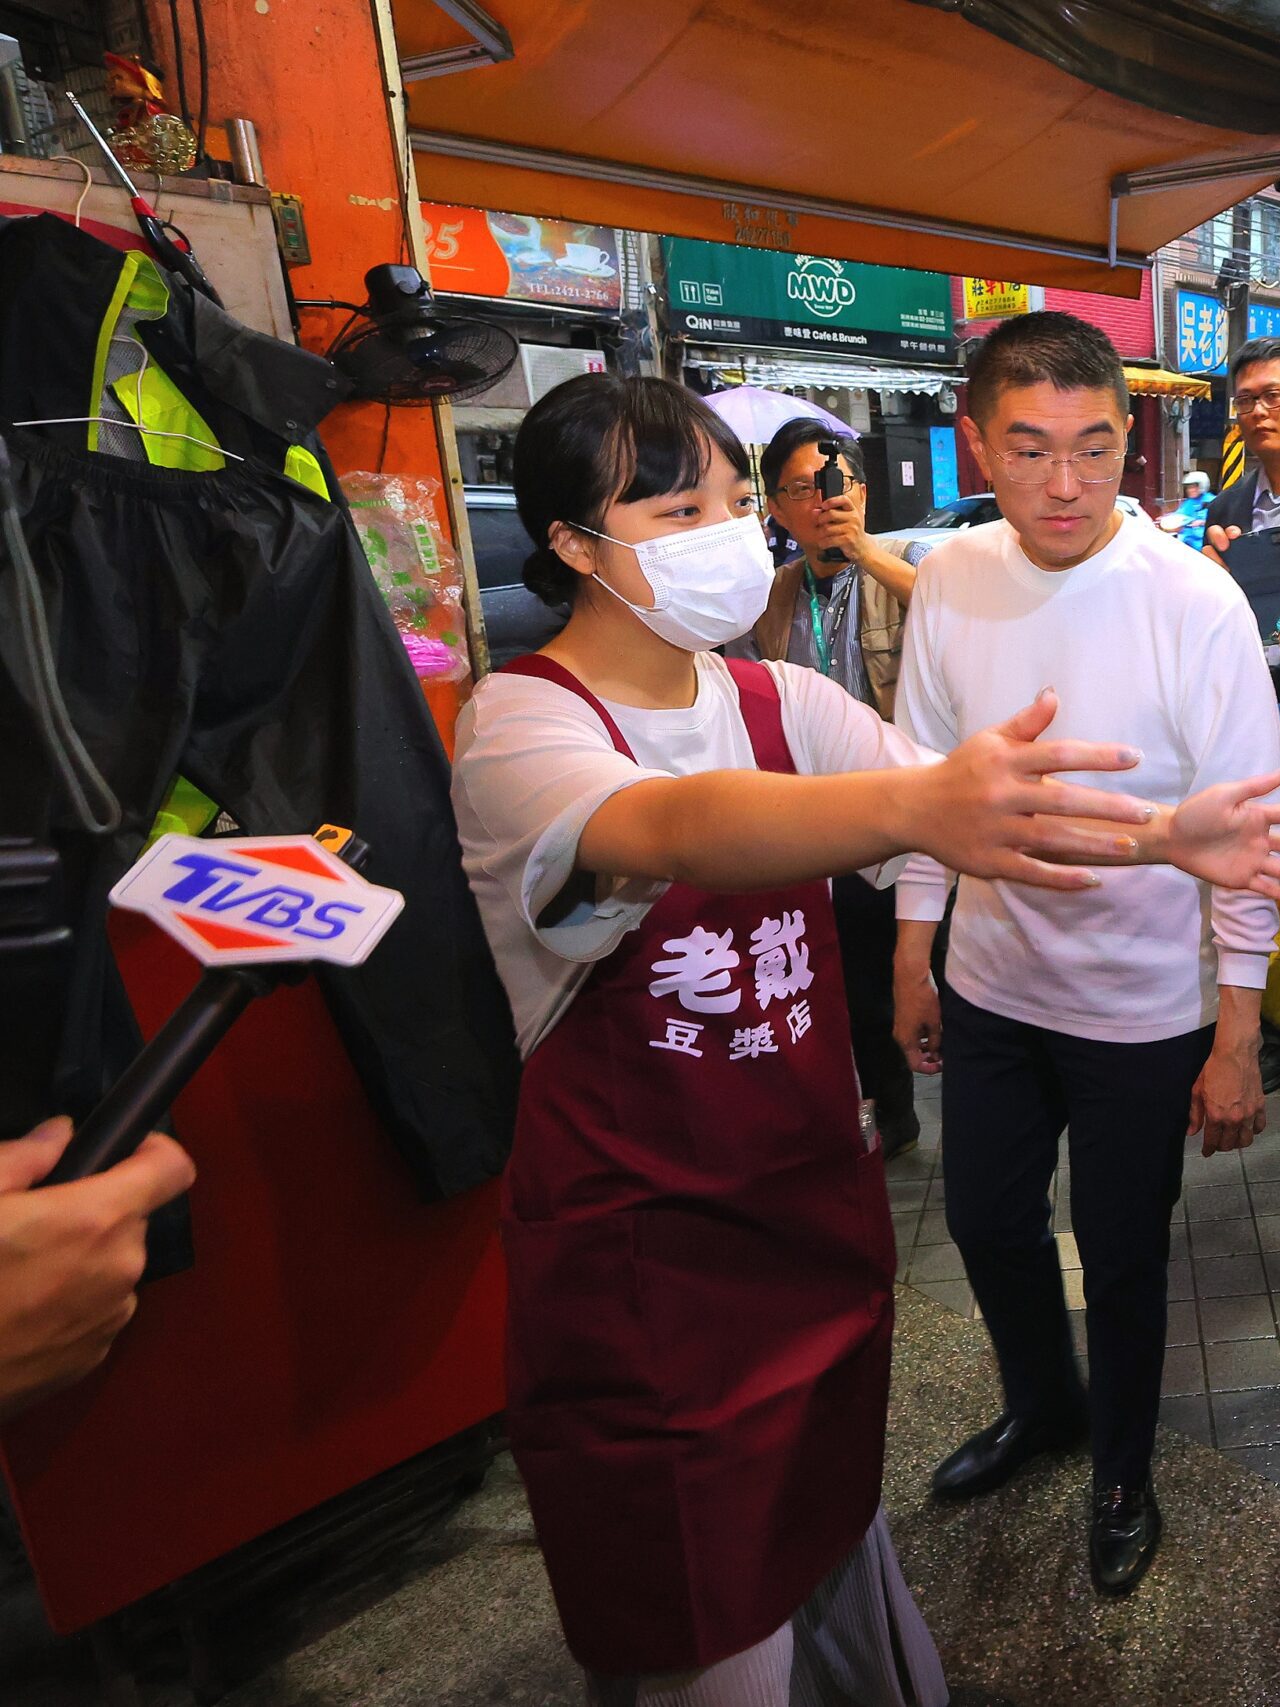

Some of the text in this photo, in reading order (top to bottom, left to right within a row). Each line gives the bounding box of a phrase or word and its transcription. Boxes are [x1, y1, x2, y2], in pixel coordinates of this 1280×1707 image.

[788, 271, 856, 306] MWD
[685, 314, 713, 331] QiN
[812, 330, 832, 341] Cafe
[838, 332, 867, 345] Brunch
[162, 853, 365, 940] TVBS
[648, 909, 815, 1014] 老戴
